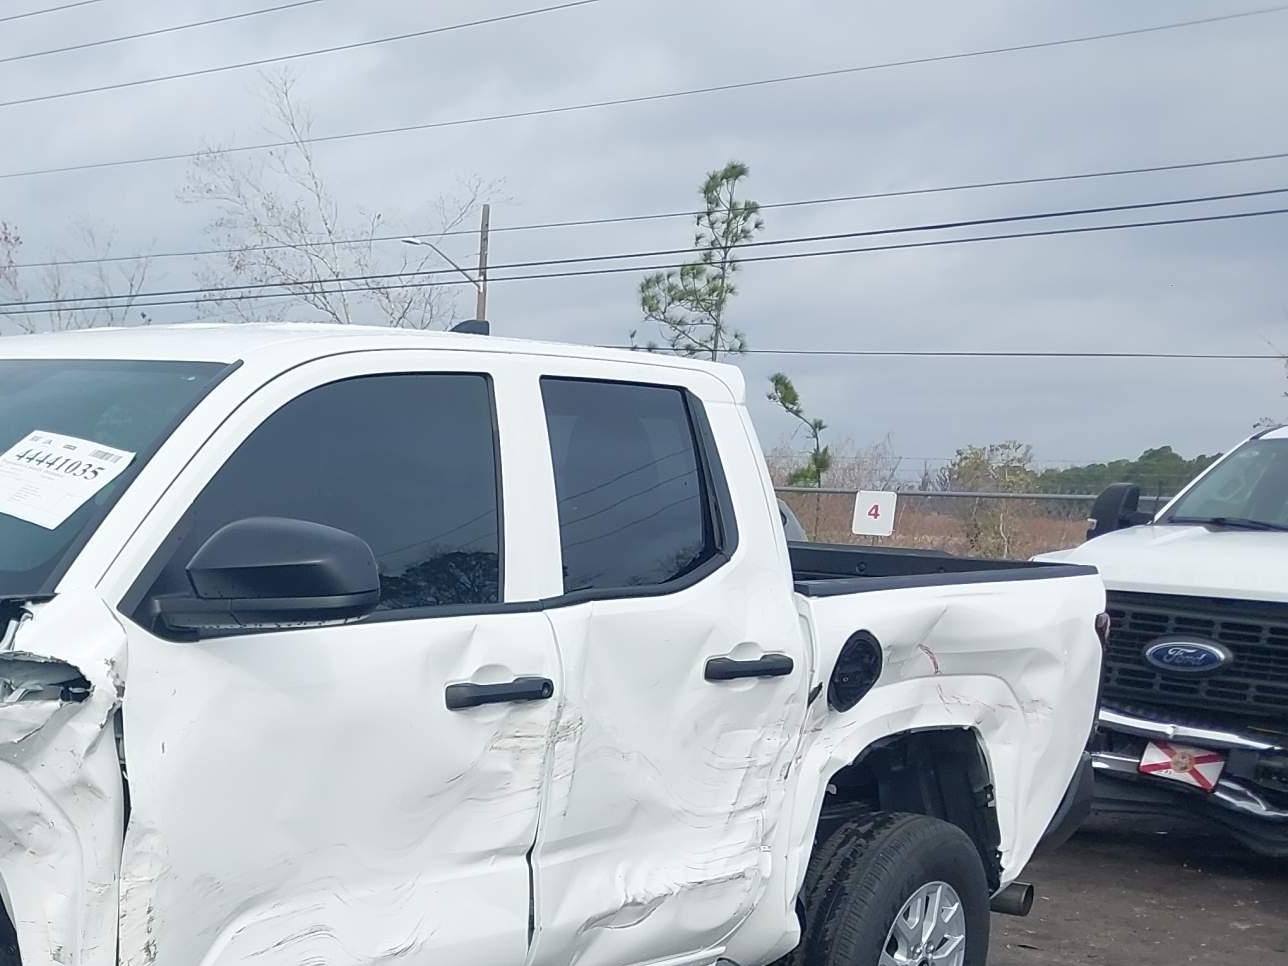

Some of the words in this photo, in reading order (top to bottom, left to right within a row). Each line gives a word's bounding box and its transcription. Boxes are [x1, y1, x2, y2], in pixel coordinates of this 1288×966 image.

[16, 448, 106, 481] 44441035
[867, 504, 881, 520] 4
[1162, 644, 1207, 665] Ford
